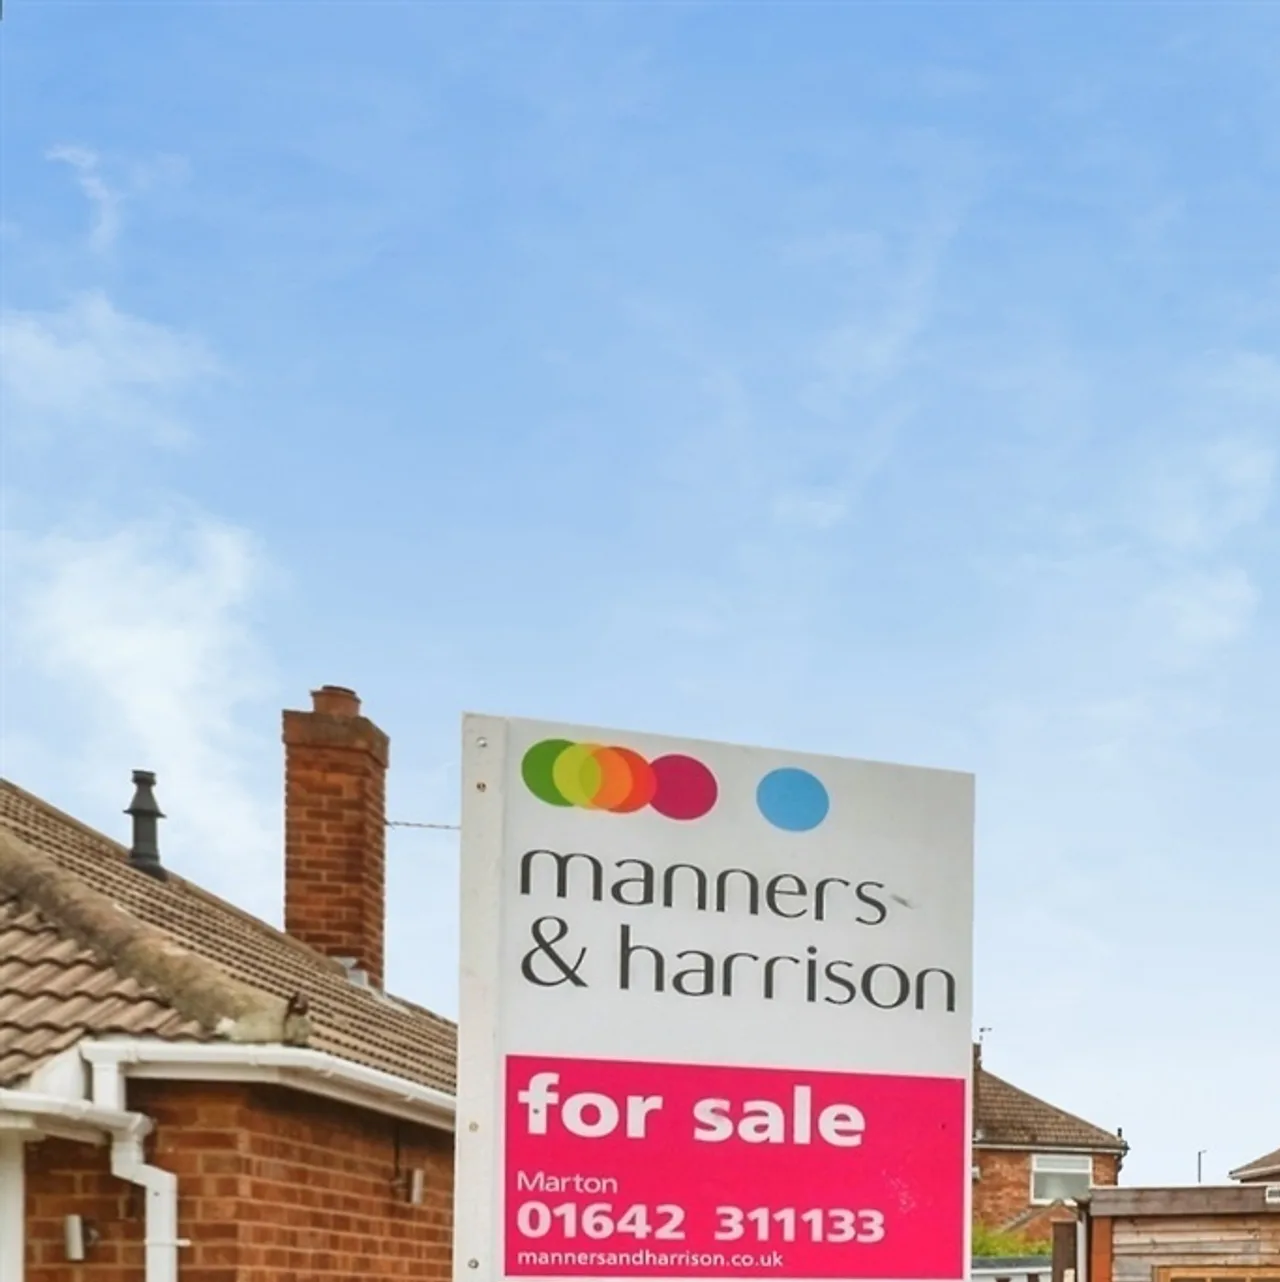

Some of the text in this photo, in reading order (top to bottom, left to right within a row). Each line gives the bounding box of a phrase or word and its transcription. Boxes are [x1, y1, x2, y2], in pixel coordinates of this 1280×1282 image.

[521, 849, 886, 925] manners
[521, 915, 956, 1012] & harrison
[518, 1072, 866, 1147] for sale
[517, 1171, 618, 1194] Marton
[517, 1202, 886, 1244] 01642 311133
[517, 1249, 784, 1269] mannersandharrison.co.uk
